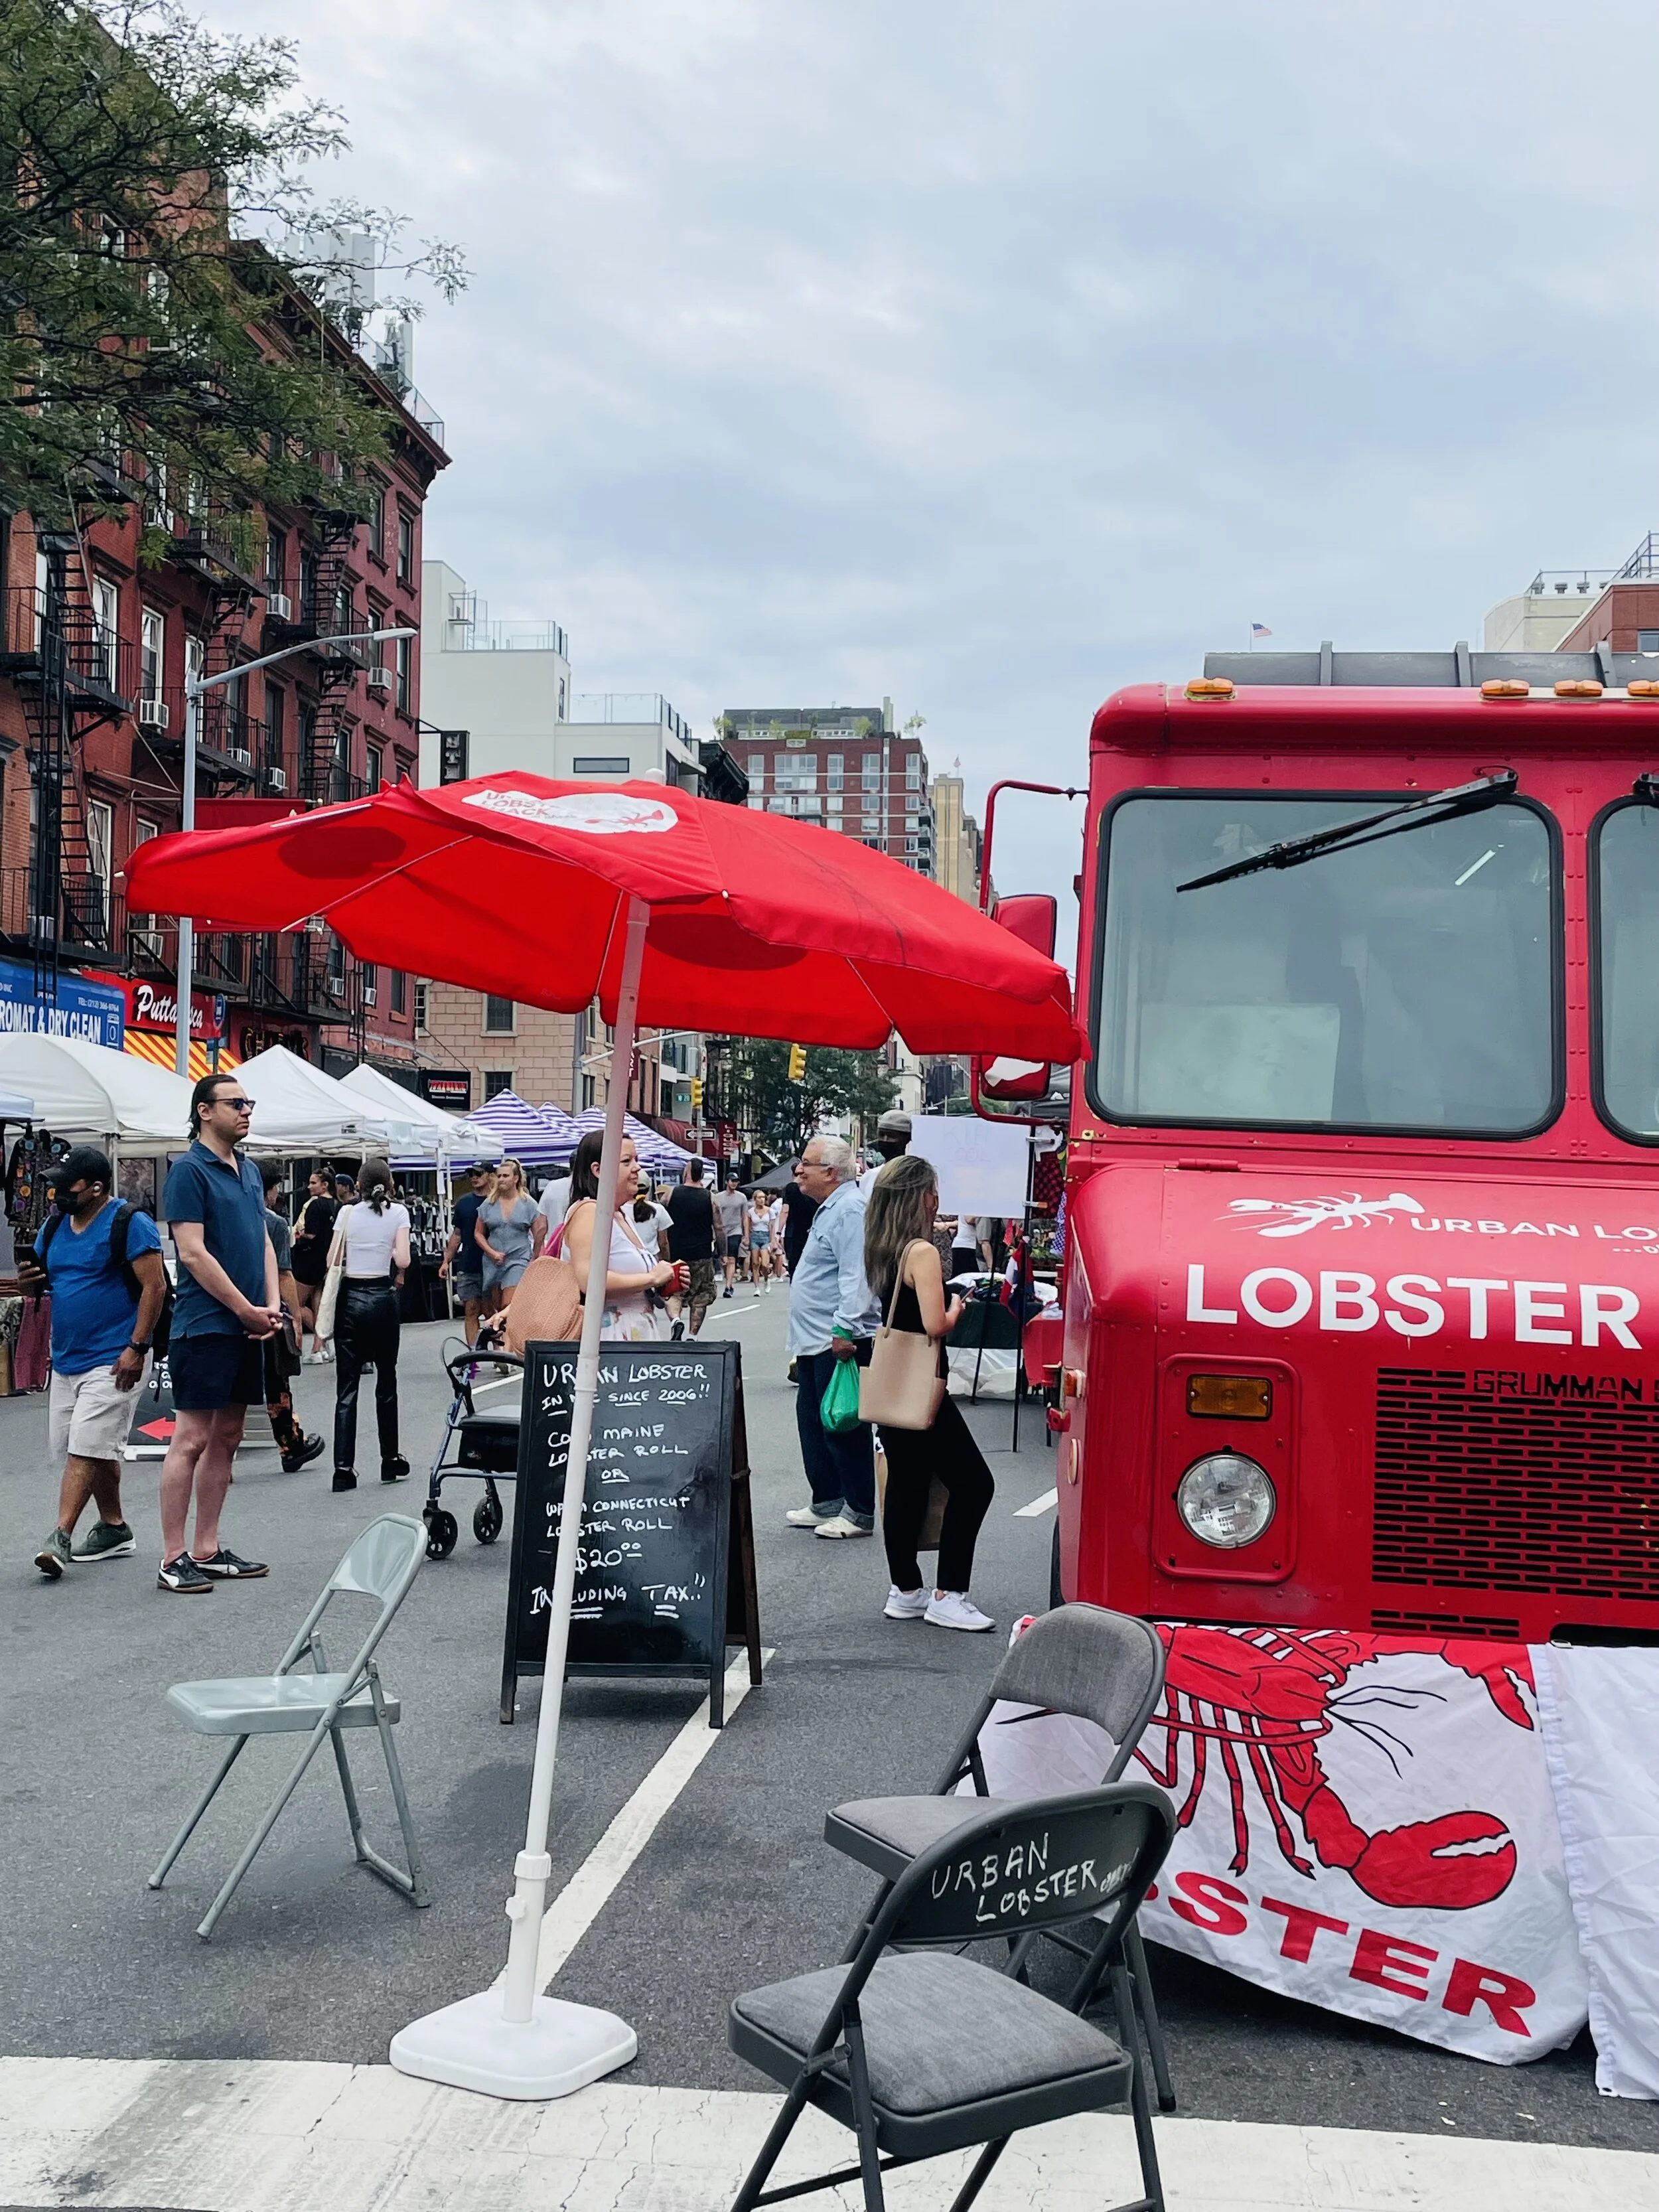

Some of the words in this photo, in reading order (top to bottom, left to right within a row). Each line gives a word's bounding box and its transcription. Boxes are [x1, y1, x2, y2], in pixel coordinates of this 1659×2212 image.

[37, 1006, 45, 1034] &
[48, 1007, 68, 1037] DRY
[70, 1011, 101, 1045] CLEAN
[1410, 1217, 1581, 1238] URBAN
[1593, 1224, 1659, 1241] LO
[1186, 1263, 1643, 1350] LOBSTER
[628, 1363, 707, 1384] LOBSTER
[1473, 1369, 1643, 1403] GRUMMAN
[541, 1394, 563, 1411] IN
[608, 1390, 650, 1403] SINCE
[603, 1423, 665, 1441] MAINE
[633, 1443, 689, 1457] ROLL
[601, 1467, 630, 1480] OR
[592, 1496, 690, 1513] CONNECTICUT
[621, 1516, 673, 1532] ROLL
[932, 1832, 1049, 1899] URBAN
[975, 1859, 1097, 1923] LOBSTER
[1143, 1871, 1536, 2038] STER
